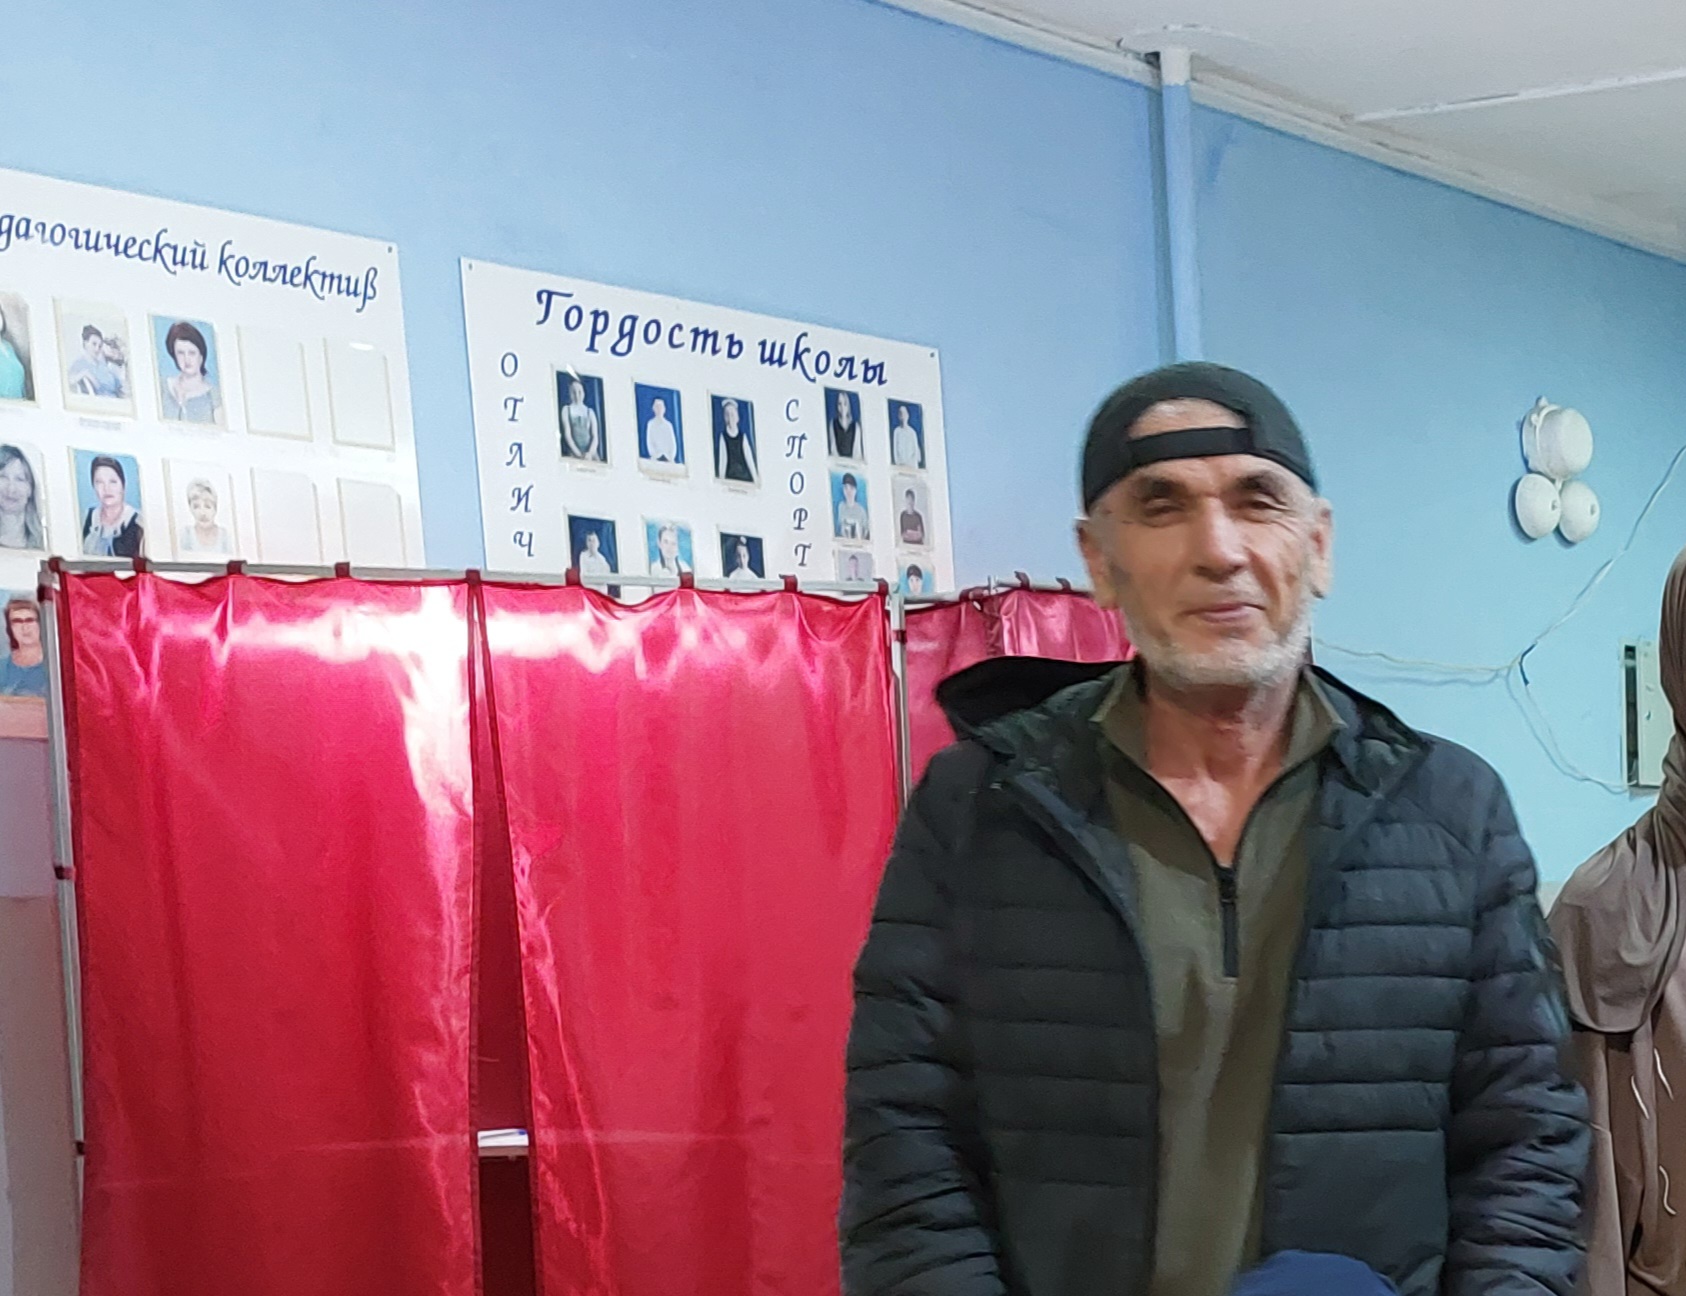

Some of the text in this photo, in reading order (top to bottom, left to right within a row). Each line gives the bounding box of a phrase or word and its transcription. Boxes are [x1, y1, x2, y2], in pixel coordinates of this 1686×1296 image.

[217, 239, 379, 313] коллектив
[535, 289, 888, 384] Гордость школы
